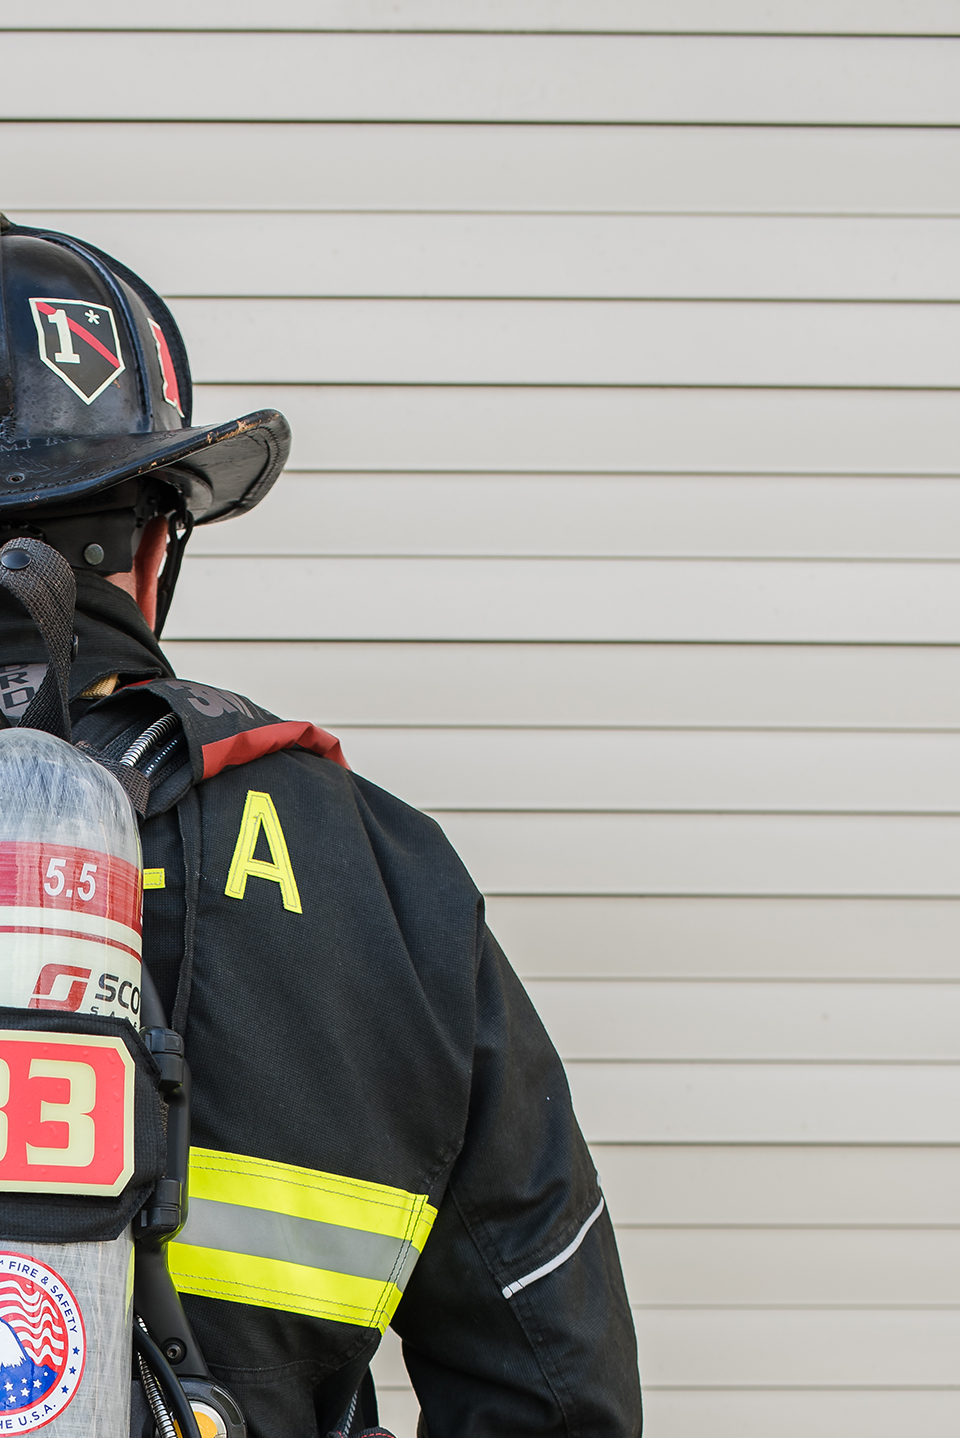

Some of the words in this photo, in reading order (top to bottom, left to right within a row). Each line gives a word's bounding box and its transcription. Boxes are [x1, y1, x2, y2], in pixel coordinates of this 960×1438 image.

[43, 858, 97, 901] 5.5
[8, 1260, 39, 1279] FIRE
[41, 1275, 49, 1286] &
[50, 1285, 78, 1334] SAFETY
[18, 1403, 57, 1427] U.S.A.
